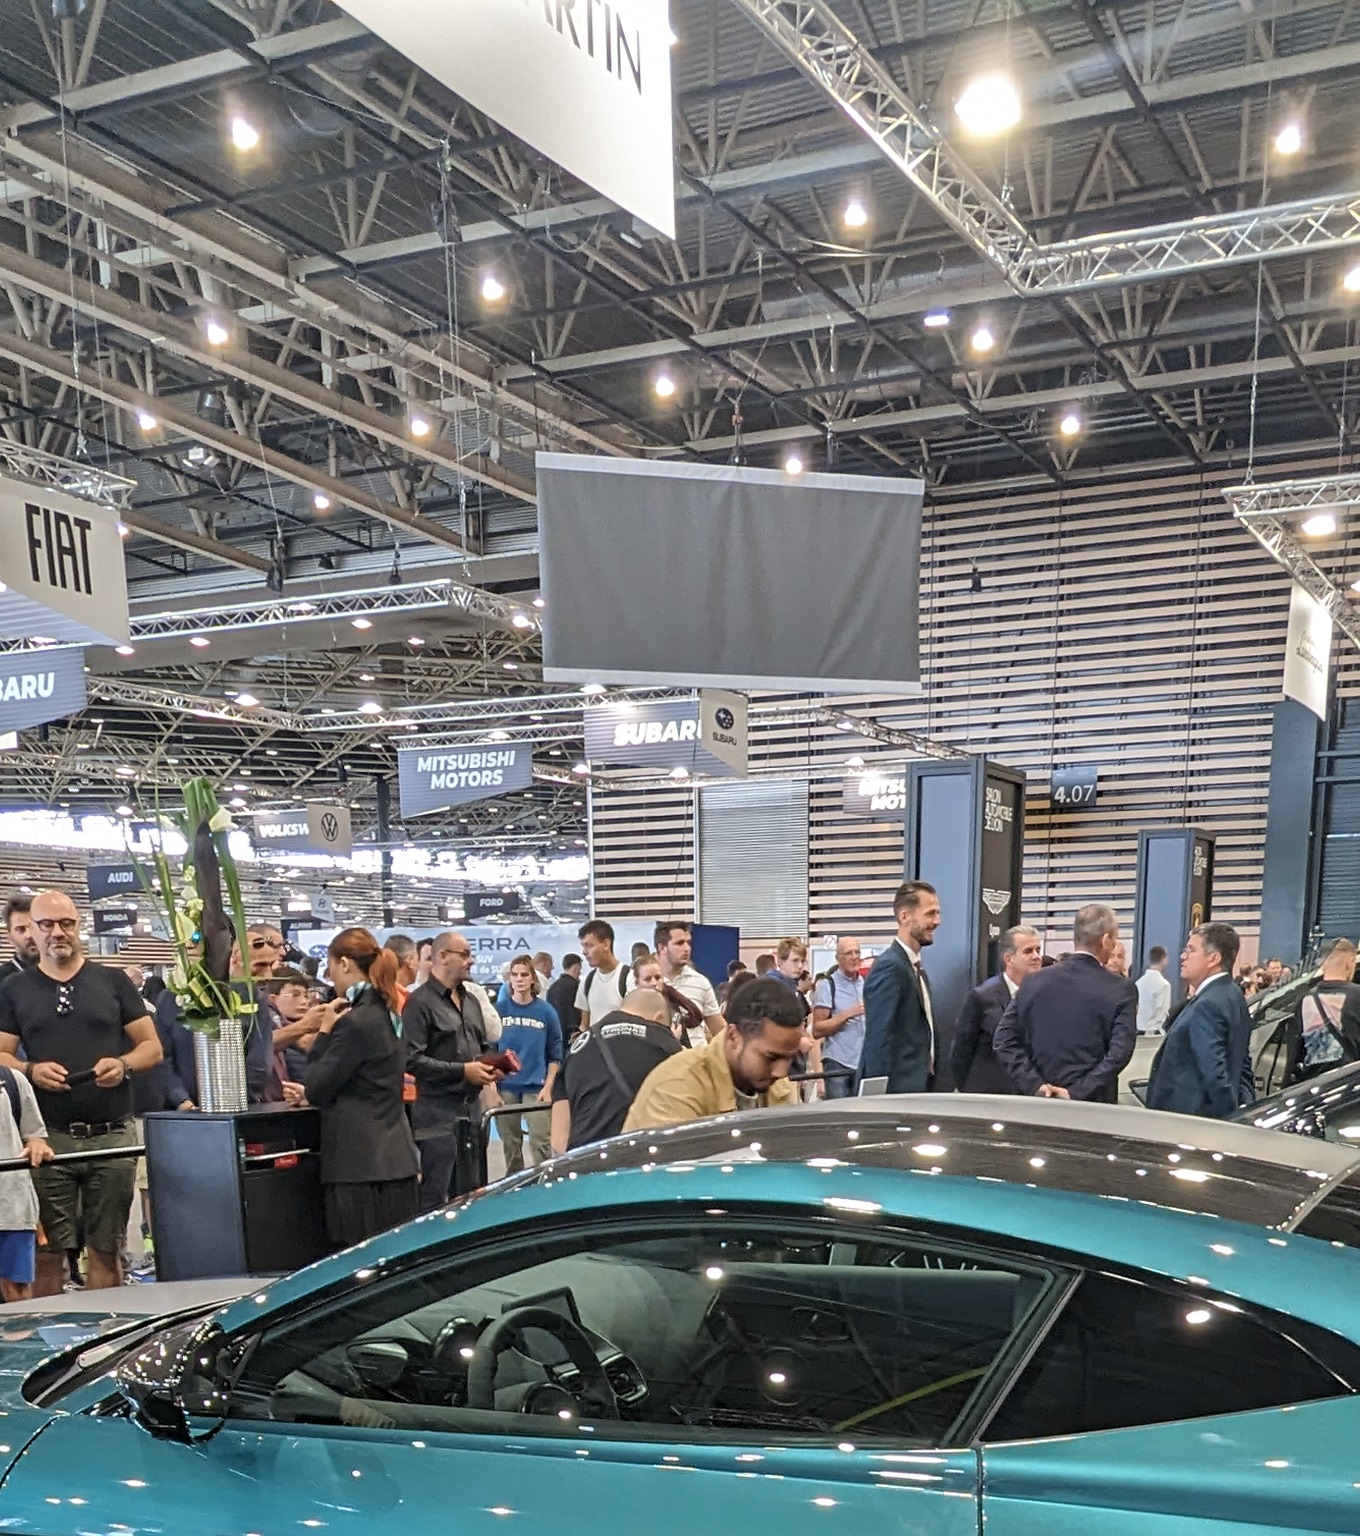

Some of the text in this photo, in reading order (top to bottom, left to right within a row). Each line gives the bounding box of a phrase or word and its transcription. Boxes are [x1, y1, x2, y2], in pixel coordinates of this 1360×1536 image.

[24, 502, 93, 595] FIAT
[712, 731, 738, 747] SUBARU
[417, 750, 516, 773] MITSUBISHI
[430, 769, 504, 790] MOTORS
[1054, 784, 1094, 803] 4.07
[107, 871, 134, 884] AUDI
[479, 897, 504, 908] FORD
